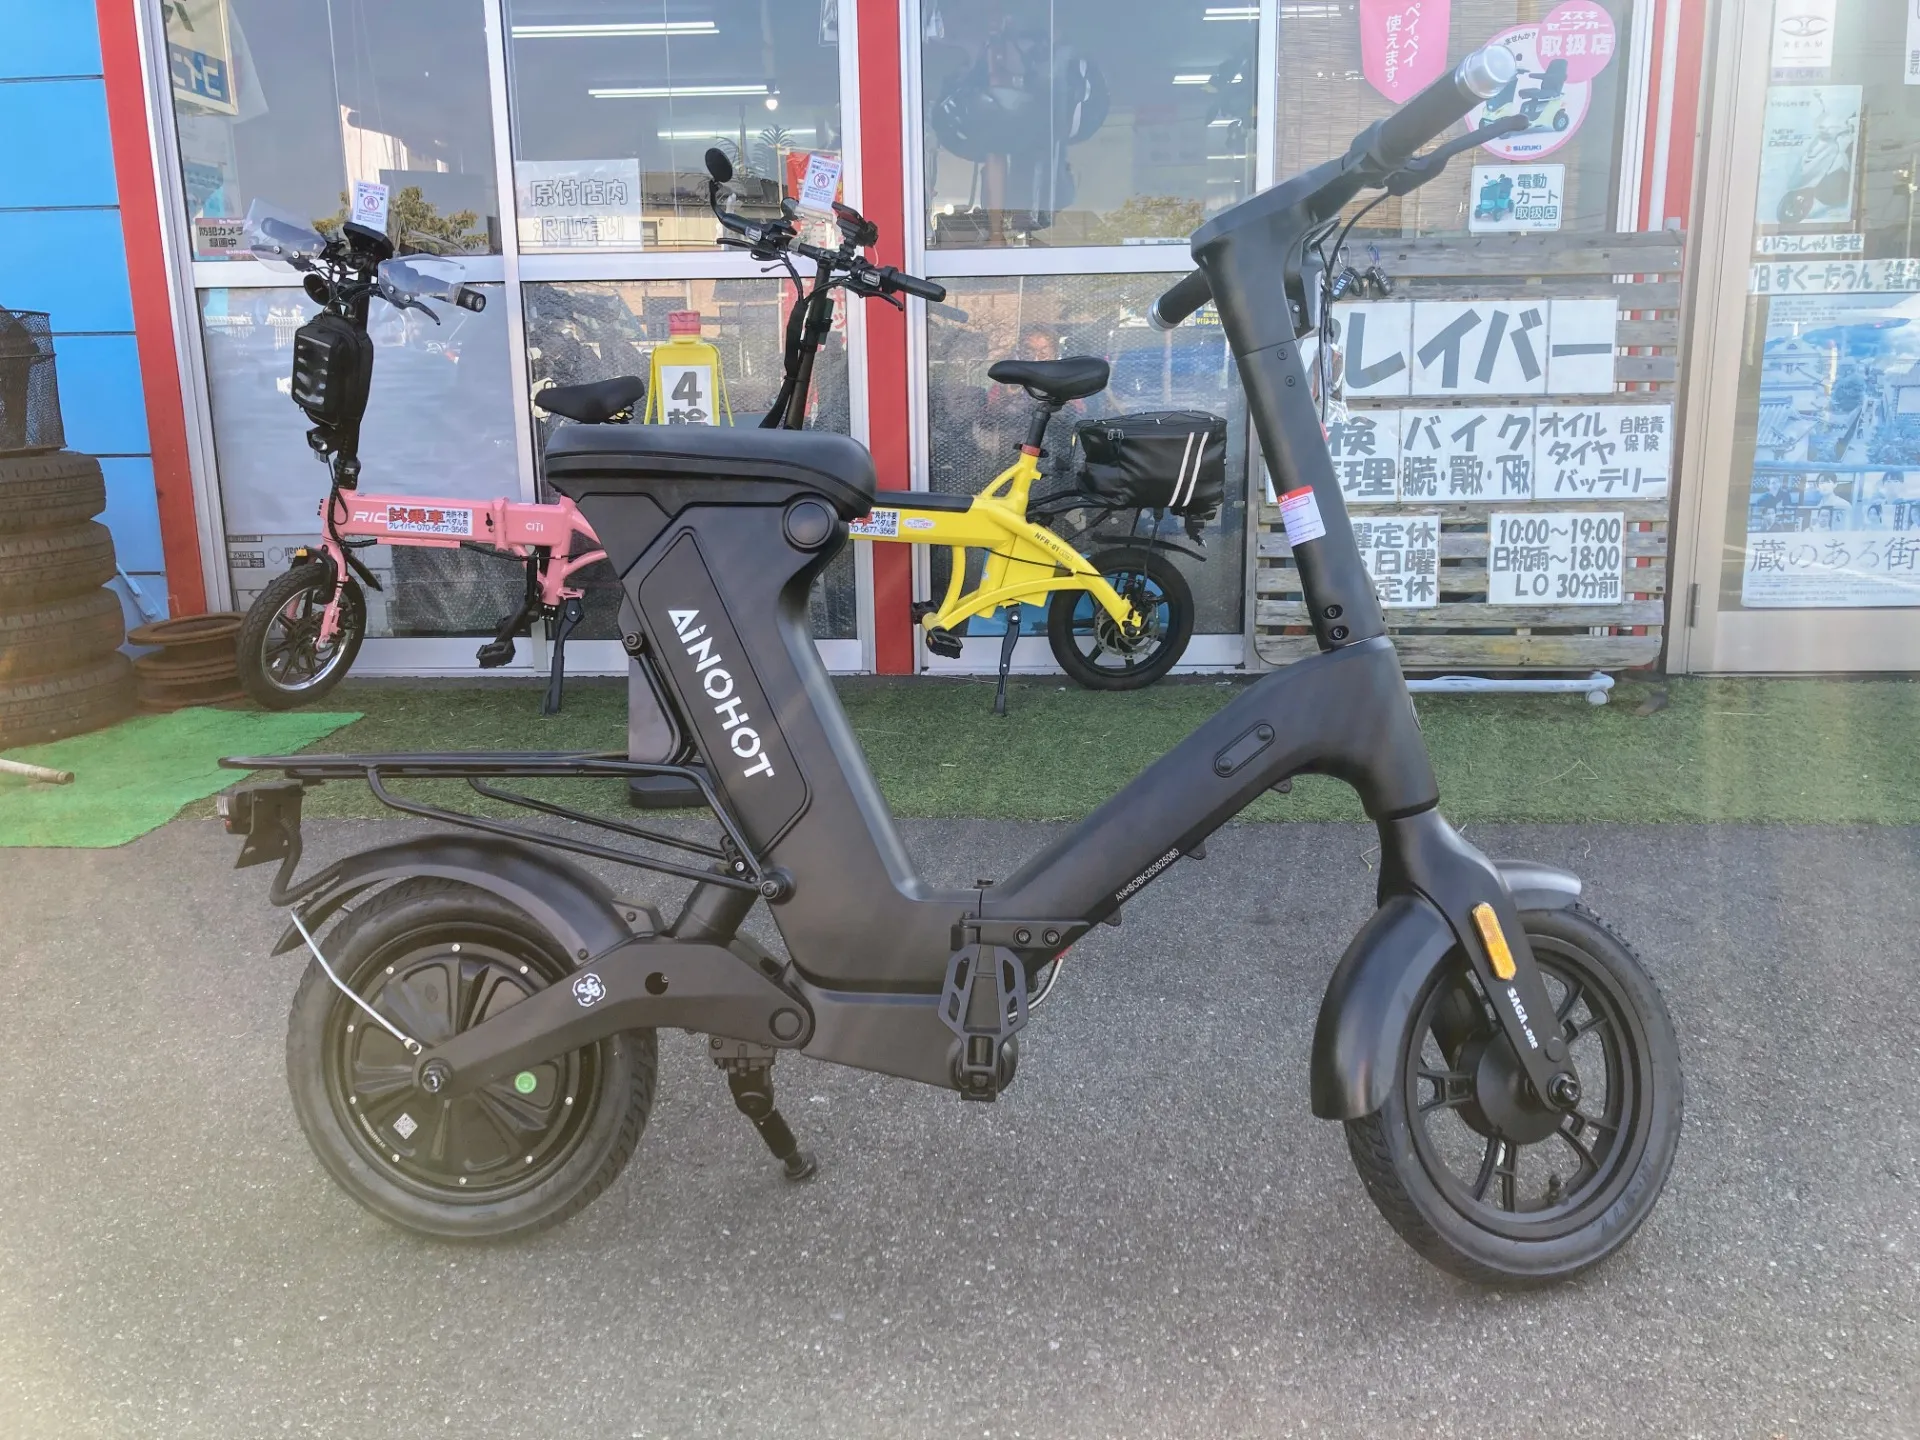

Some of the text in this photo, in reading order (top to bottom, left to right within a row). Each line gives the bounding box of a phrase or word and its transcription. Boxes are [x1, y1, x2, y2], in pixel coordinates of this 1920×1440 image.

[1560, 11, 1598, 21] スズキ
[1404, 3, 1420, 67] ペイペイ
[1547, 22, 1609, 31] セニアカー
[1385, 14, 1402, 88] 使えます。
[1541, 34, 1612, 57] 取扱店
[1518, 172, 1547, 189] 電動
[530, 179, 628, 207] 原付店内
[1516, 189, 1559, 205] カート
[1515, 205, 1557, 220] 取扱店
[198, 226, 243, 237] 防犯カメラ
[1403, 413, 1532, 452] バイク
[1540, 412, 1607, 437] オイル
[1620, 416, 1664, 434] 自賠責
[1547, 440, 1616, 466] タイヤ
[1624, 434, 1659, 452] 保険
[1554, 467, 1667, 493] バッテリー
[388, 507, 446, 525] 試乗車
[416, 523, 469, 534] 070-5677-3568
[525, 522, 544, 532] CITI
[1751, 537, 1920, 573] 蔵のある街
[1556, 572, 1620, 599] 30分前
[668, 610, 775, 778] AINOHOT
